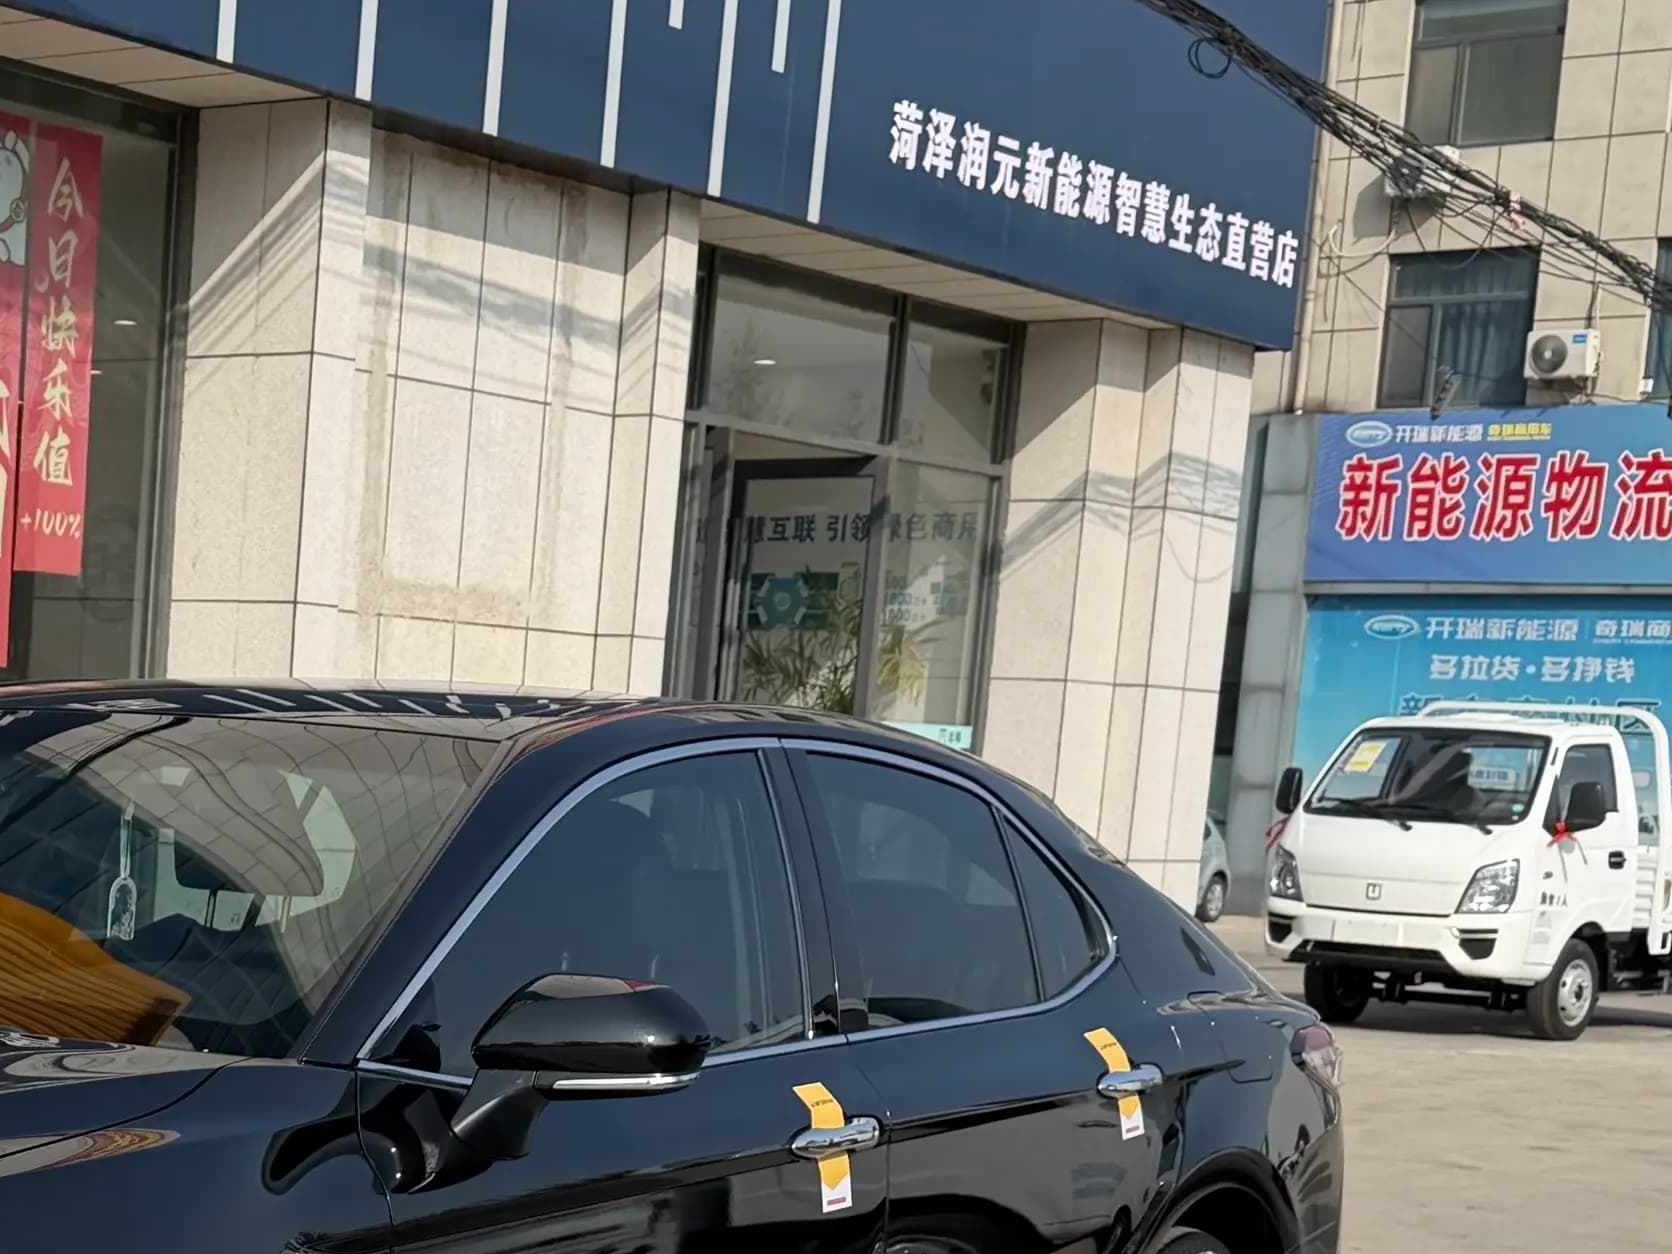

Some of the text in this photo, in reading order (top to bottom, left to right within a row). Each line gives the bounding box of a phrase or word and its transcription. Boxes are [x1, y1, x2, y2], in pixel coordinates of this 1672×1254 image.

[889, 100, 1299, 288] 菏泽润元新能源智慧生态直营店
[32, 157, 84, 486] 今日快乐值
[1395, 423, 1483, 443] 开瑞新能源
[1336, 450, 1672, 541] 新能源物流
[1426, 616, 1578, 641] 开瑞新能源
